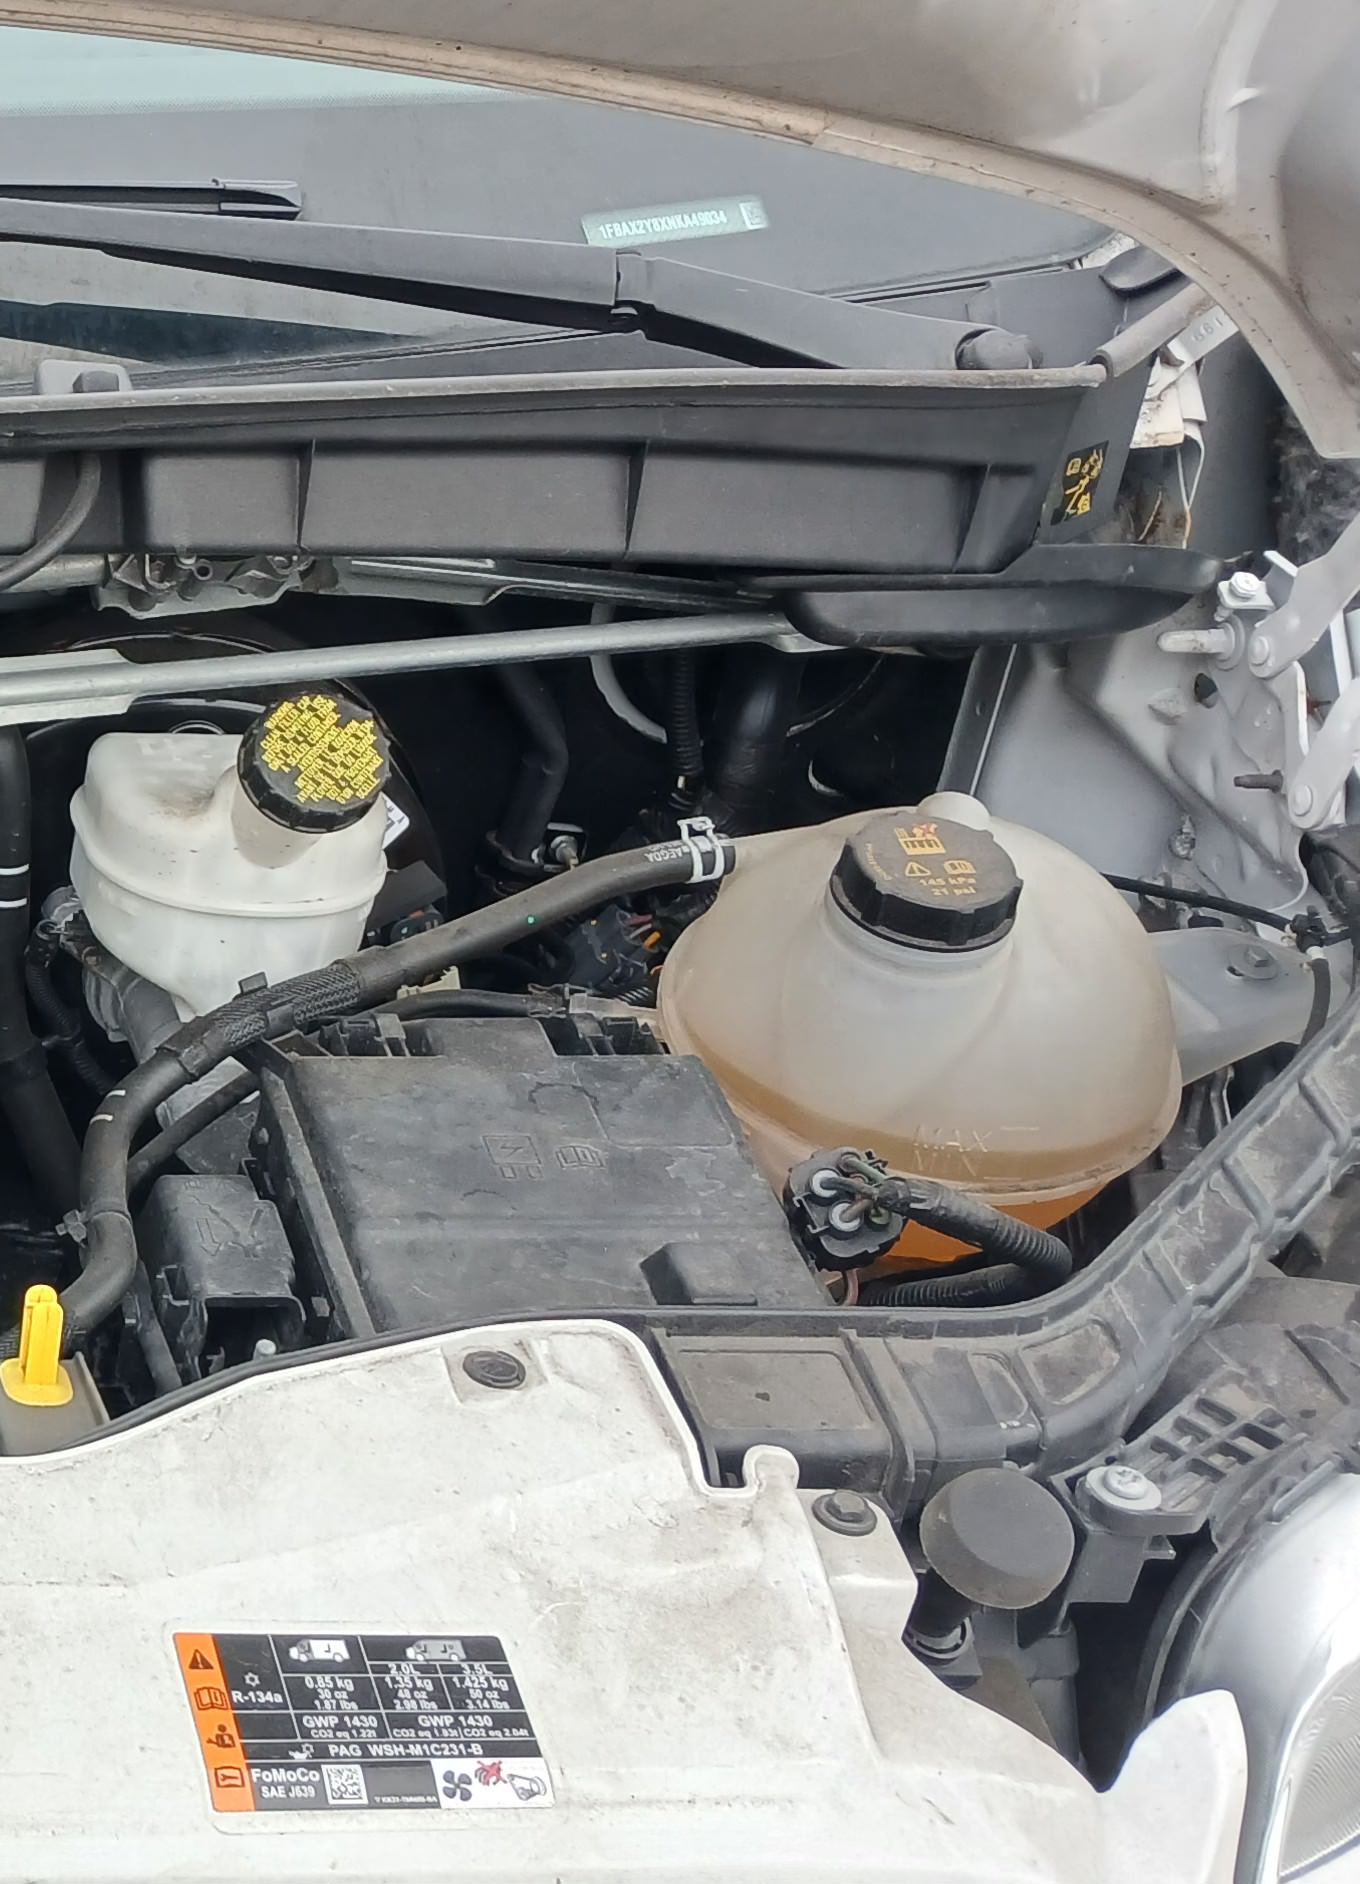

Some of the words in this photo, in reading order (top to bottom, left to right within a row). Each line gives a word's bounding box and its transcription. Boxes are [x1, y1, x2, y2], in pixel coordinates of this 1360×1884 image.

[388, 1664, 420, 1675] 2.0L
[461, 1664, 493, 1675] 3.5L
[305, 1676, 334, 1689] 0.85
[335, 1676, 354, 1691] kg
[385, 1676, 412, 1688] 1.35
[415, 1676, 434, 1691] kg
[452, 1676, 488, 1688] 1.425
[490, 1676, 509, 1691] kg
[232, 1690, 282, 1704] R-134a
[318, 1689, 332, 1699] 30
[334, 1690, 348, 1699] oz
[414, 1690, 428, 1699] oz
[485, 1690, 500, 1699] oz
[339, 1700, 358, 1710] lbs
[419, 1700, 438, 1710] lbs
[491, 1700, 510, 1710] lbs
[302, 1715, 339, 1727] GWP
[344, 1715, 377, 1727] 1430
[418, 1715, 454, 1727] GWP
[458, 1715, 493, 1727] 1430
[310, 1729, 334, 1738] CO2
[393, 1728, 415, 1737] CO2
[464, 1728, 486, 1737] CO2
[328, 1744, 362, 1757] PAG
[368, 1742, 483, 1757] WSH-M1C231-B
[251, 1768, 320, 1783] FoMoCo
[261, 1786, 286, 1798] SAE
